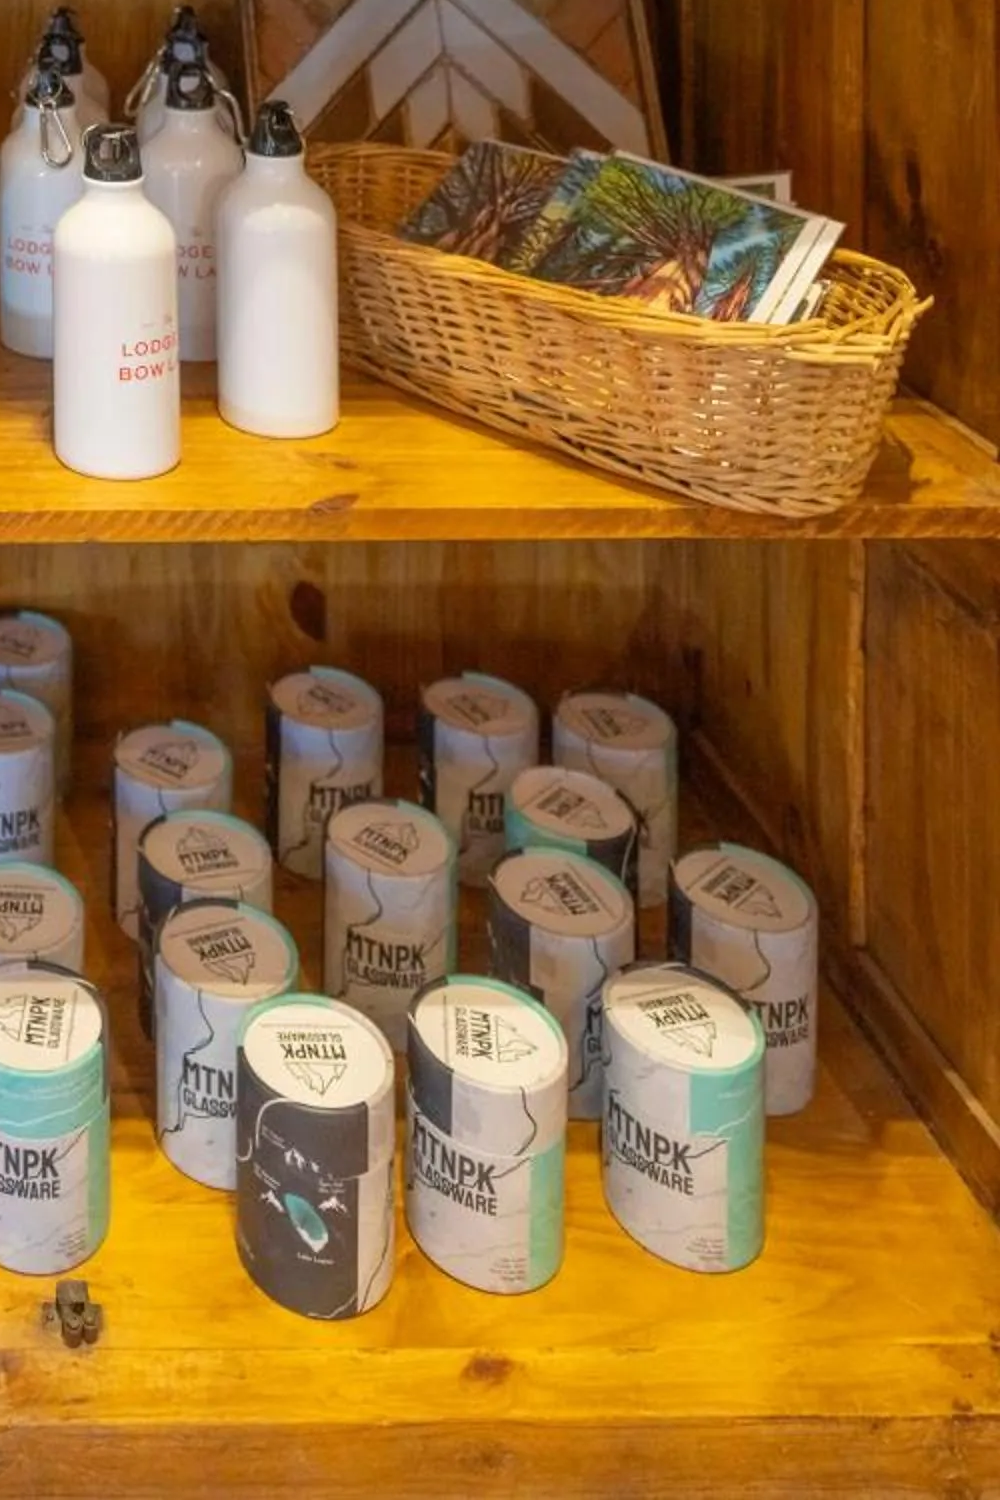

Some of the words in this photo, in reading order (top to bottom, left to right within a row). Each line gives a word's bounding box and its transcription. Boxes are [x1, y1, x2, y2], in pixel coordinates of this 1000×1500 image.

[7, 237, 55, 256] LODG
[6, 256, 42, 275] BOW
[119, 361, 164, 381] BOW
[346, 930, 426, 970] MTNPK
[24, 996, 50, 1046] MTNPK
[649, 1002, 711, 1029] MTNPK
[752, 993, 810, 1030] TNPK
[279, 1043, 348, 1060] MTNPK
[471, 1009, 495, 1064] MTNPK
[183, 1058, 234, 1100] MTN
[183, 1088, 237, 1119] GLASS
[607, 1095, 693, 1175] MTNPK
[413, 1115, 497, 1196] MTNPK
